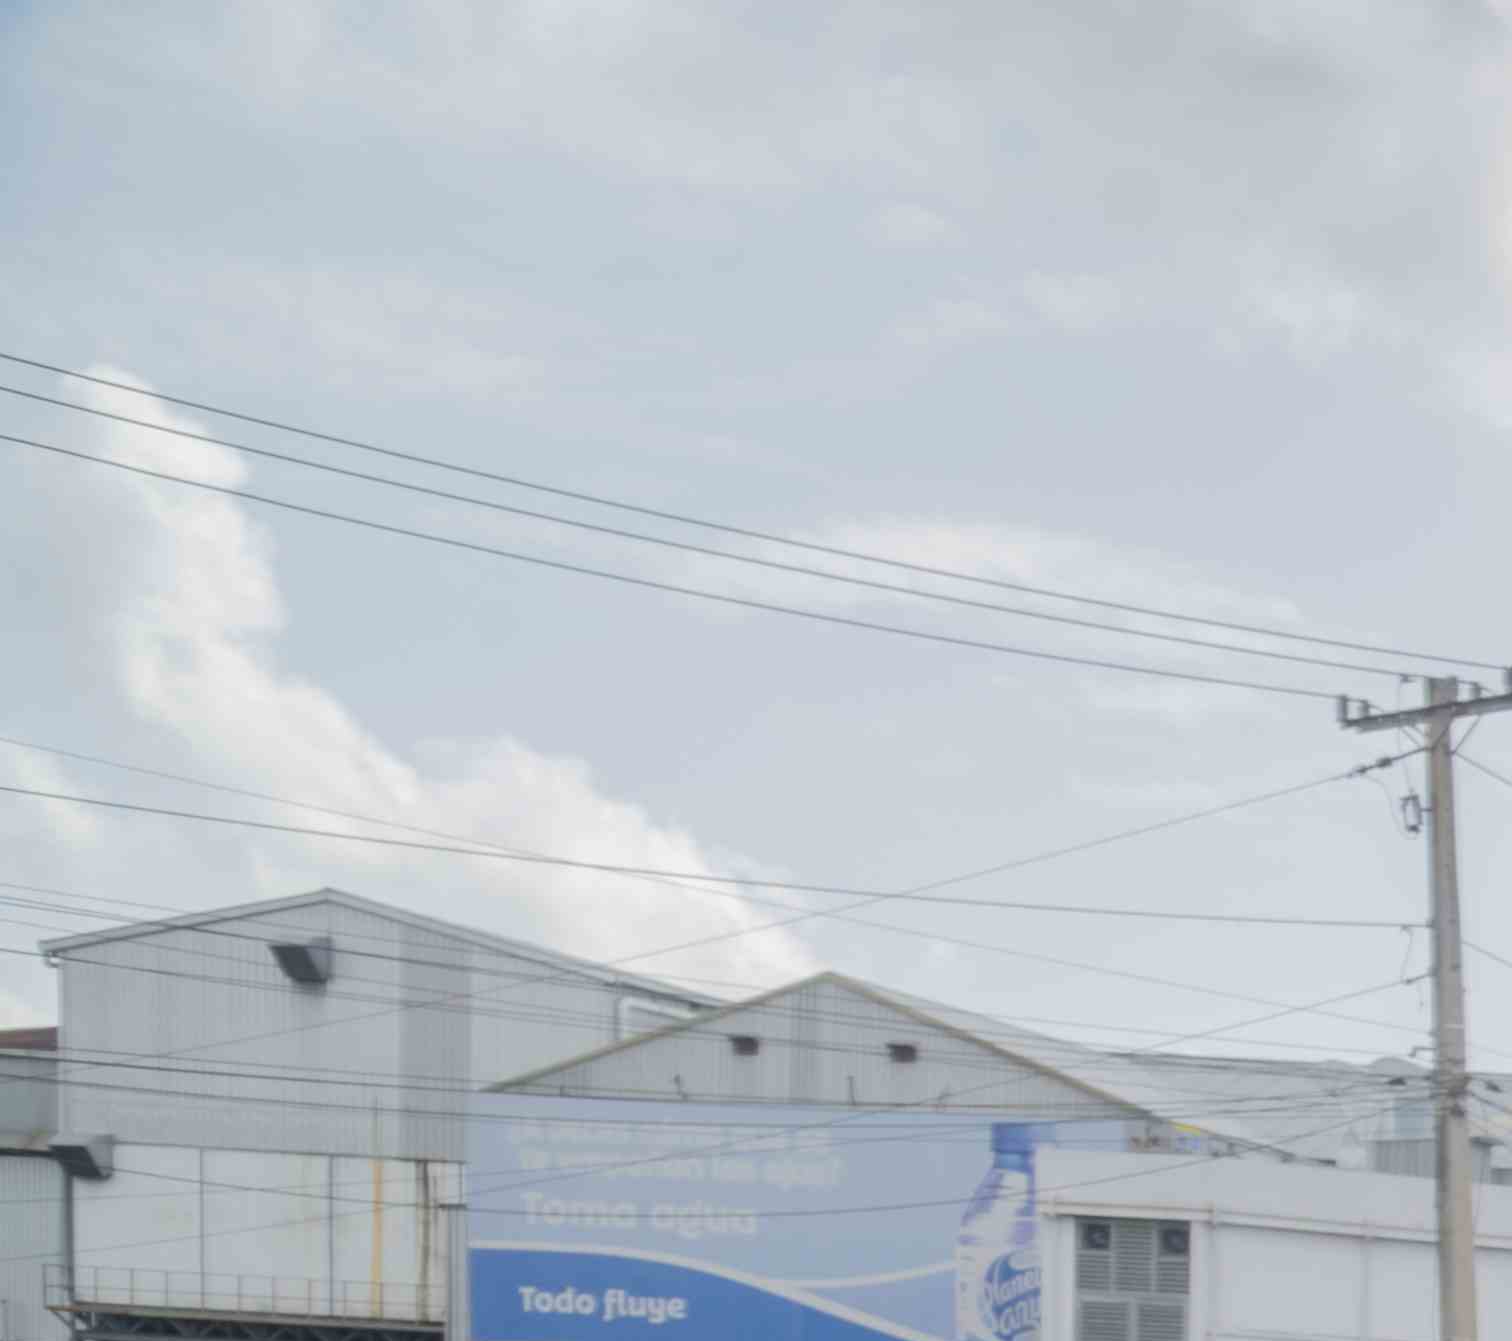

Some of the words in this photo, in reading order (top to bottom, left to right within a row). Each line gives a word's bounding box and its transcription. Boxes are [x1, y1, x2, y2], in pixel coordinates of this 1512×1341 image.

[520, 1192, 637, 1230] Toma
[650, 1200, 758, 1238] agua
[518, 1286, 598, 1315] Todo
[603, 1288, 688, 1324] fluye
